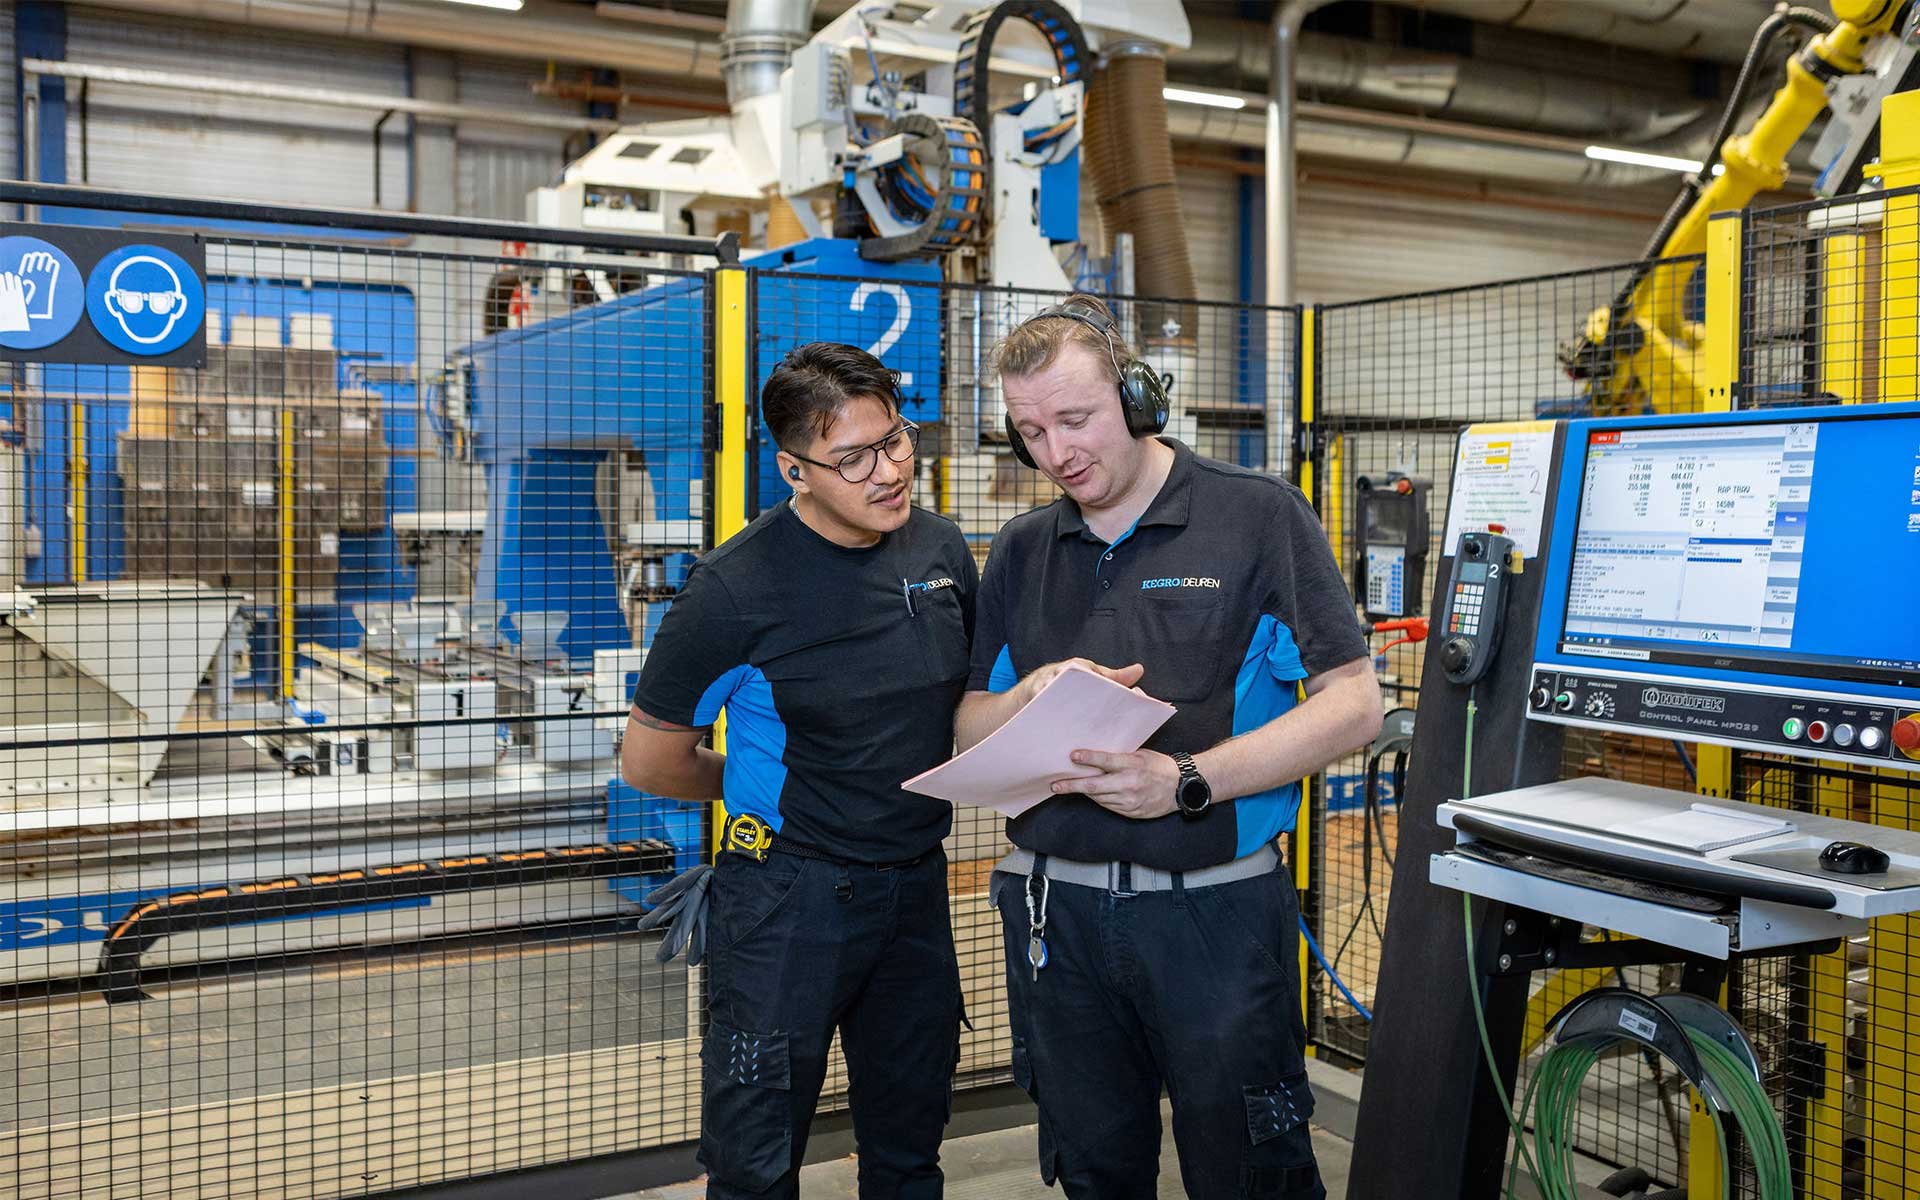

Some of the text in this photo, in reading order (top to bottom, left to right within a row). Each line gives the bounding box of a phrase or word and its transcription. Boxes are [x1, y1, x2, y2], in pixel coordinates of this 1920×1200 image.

[850, 283, 912, 384] 2
[1488, 564, 1499, 579] 2
[1141, 577, 1220, 590] KEGRO DEUREN
[1714, 659, 1733, 667] acer
[451, 689, 464, 717] 1
[1660, 693, 1723, 711] HOUFEK
[1640, 710, 1683, 723] CONTROL
[1686, 716, 1719, 728] PANEL
